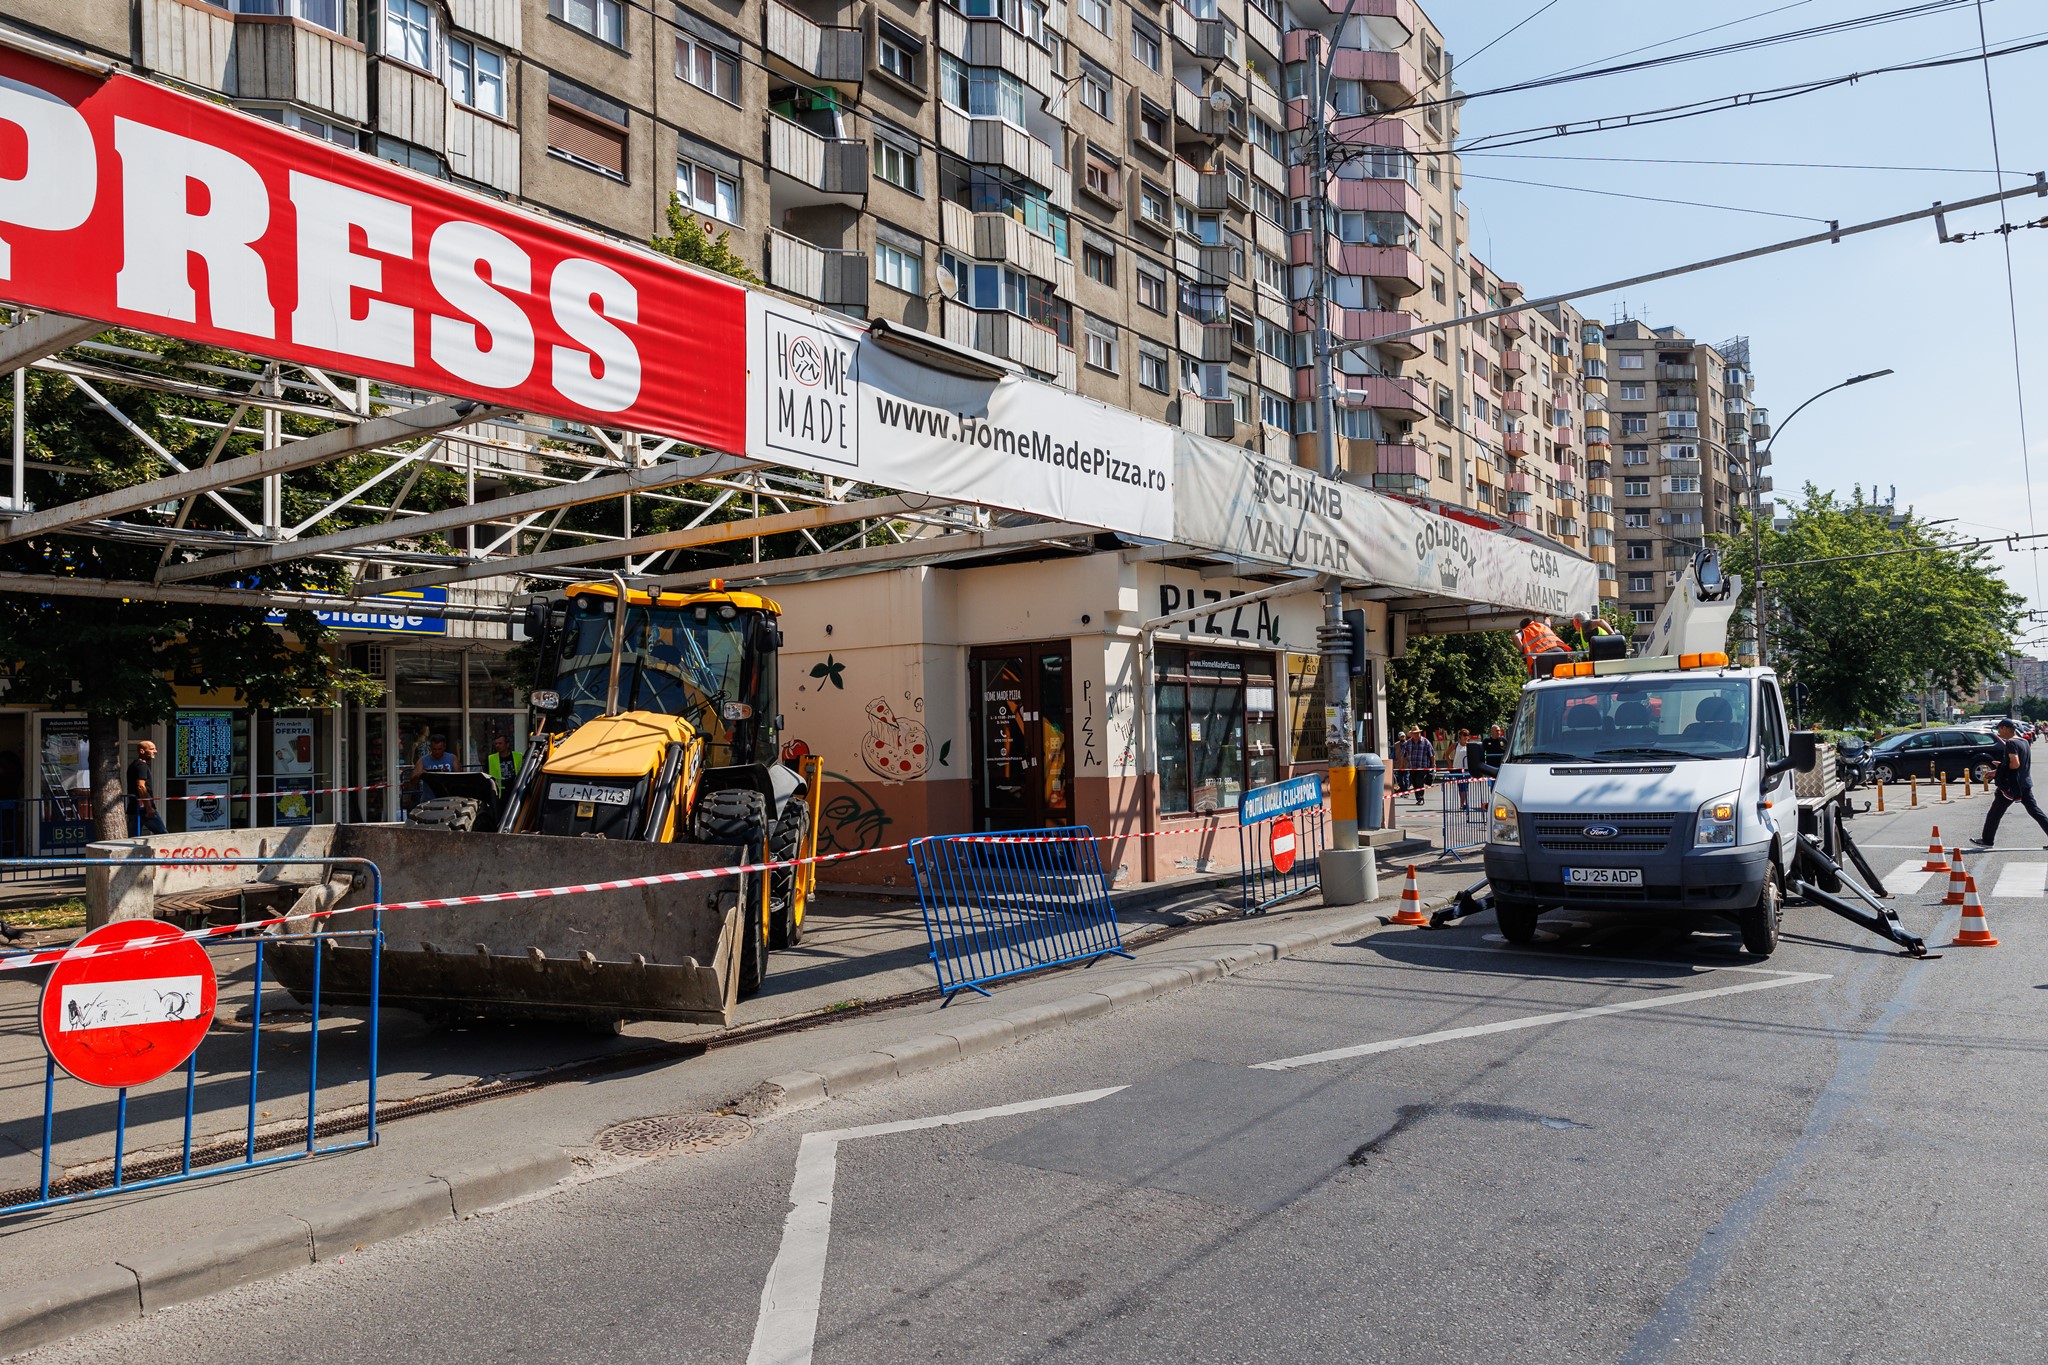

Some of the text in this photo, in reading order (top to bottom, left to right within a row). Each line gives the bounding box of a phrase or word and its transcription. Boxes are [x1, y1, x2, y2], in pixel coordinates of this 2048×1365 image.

[779, 386, 848, 449] MADE
[876, 396, 1166, 492] www.HomeMadePizza.ro
[1245, 516, 1350, 571] VALUTAR
[1415, 520, 1477, 577] GOLDBOX
[1160, 584, 1272, 641] PIZZA
[1525, 583, 1568, 613] AMANET
[1189, 658, 1241, 670] www.HomeMadePizza.ro
[595, 788, 625, 803] 2143
[1263, 790, 1283, 812] LOCALA
[1283, 782, 1317, 808] CLUJ-NAPOCA
[55, 827, 85, 840] BSG
[1589, 827, 1610, 836] Ford
[1572, 870, 1588, 882] CJ
[1593, 870, 1609, 882] 25
[1612, 871, 1639, 882] ADP
